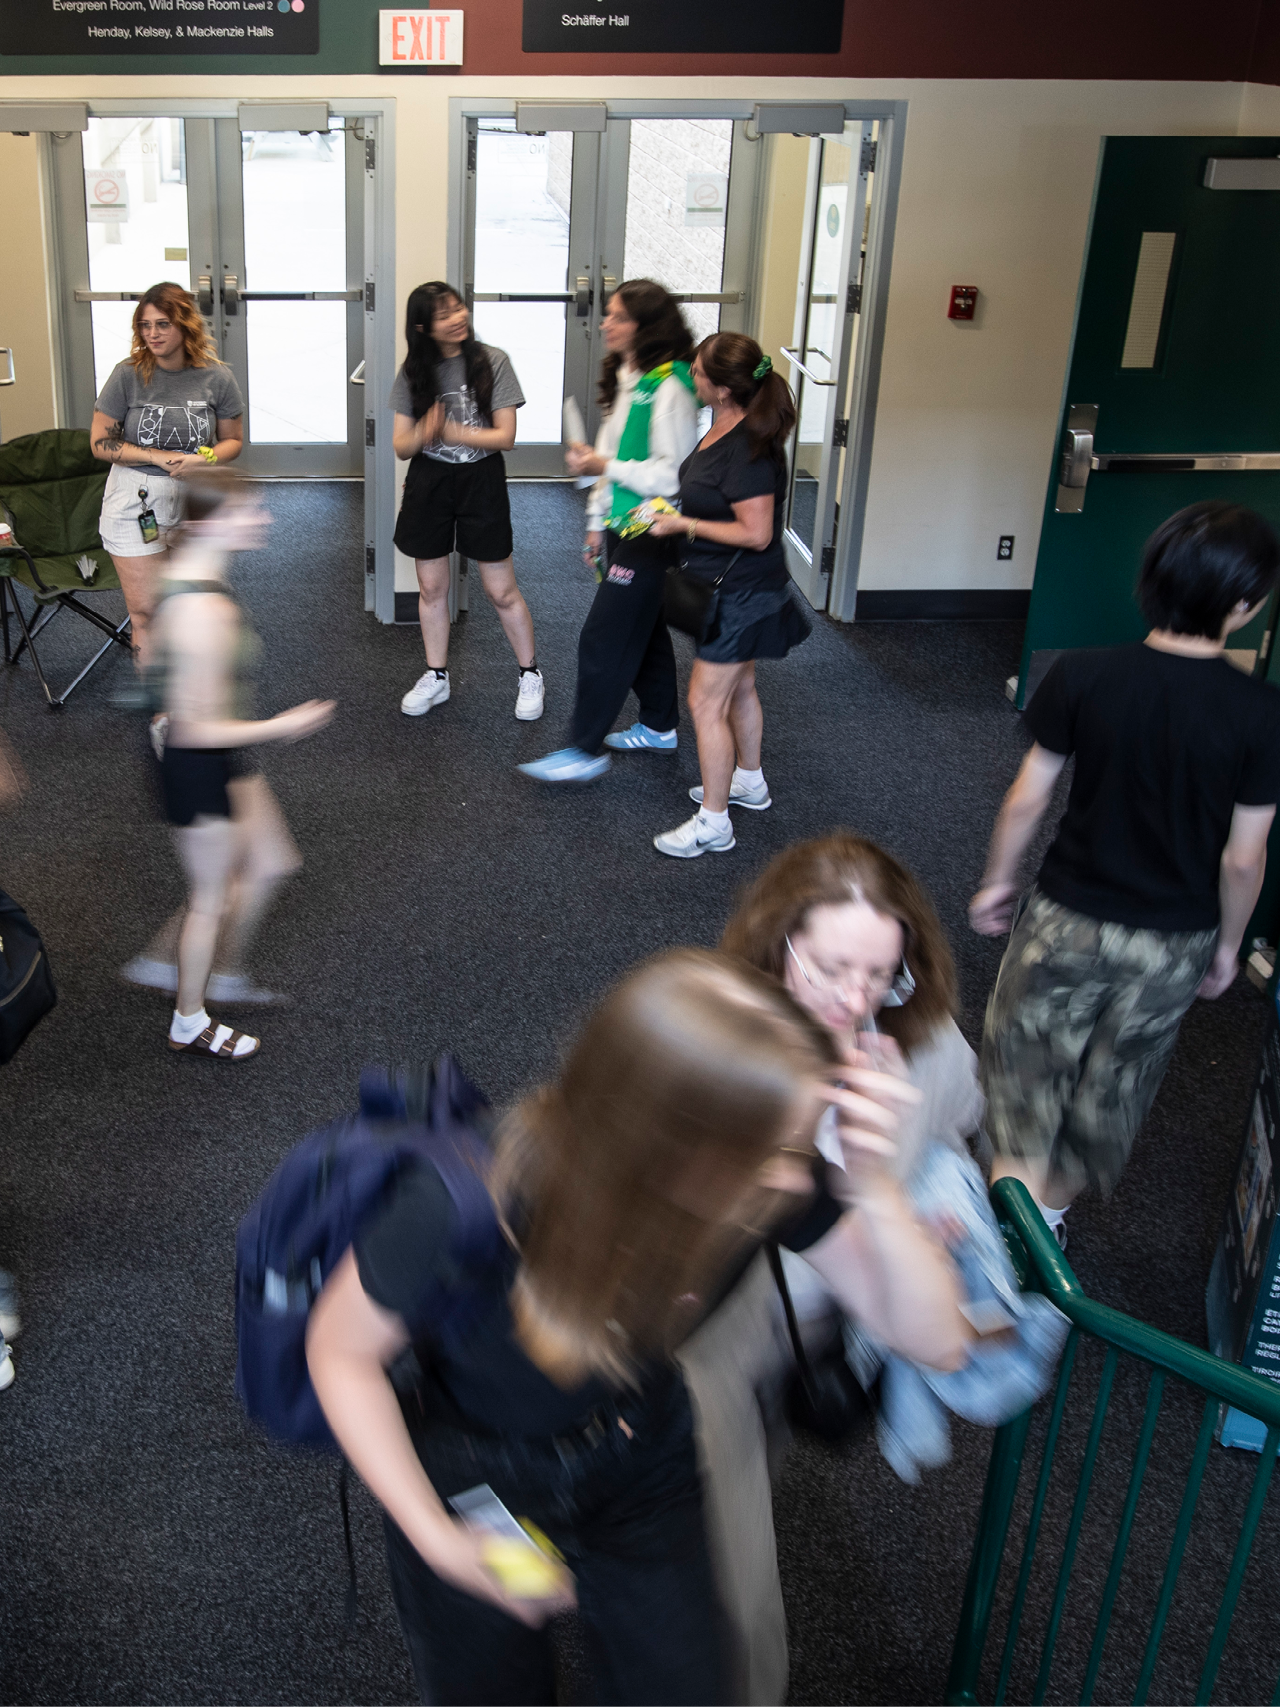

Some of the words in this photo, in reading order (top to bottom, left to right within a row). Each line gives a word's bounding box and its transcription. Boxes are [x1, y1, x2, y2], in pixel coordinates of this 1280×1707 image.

[53, 0, 107, 13] Evergreen
[109, 0, 146, 12] Room,
[148, 0, 174, 10] Wild
[176, 0, 205, 10] Rose
[207, 0, 240, 10] Room
[243, 1, 266, 11] Level
[267, 2, 274, 11] 2
[561, 14, 607, 26] Schäffer
[608, 14, 629, 26] Hall
[88, 26, 132, 39] Henday,
[134, 26, 173, 39] Kelsey,
[175, 26, 185, 37] &
[186, 26, 245, 37] Mackenzie
[247, 26, 275, 38] Halls
[391, 16, 451, 61] EXIT
